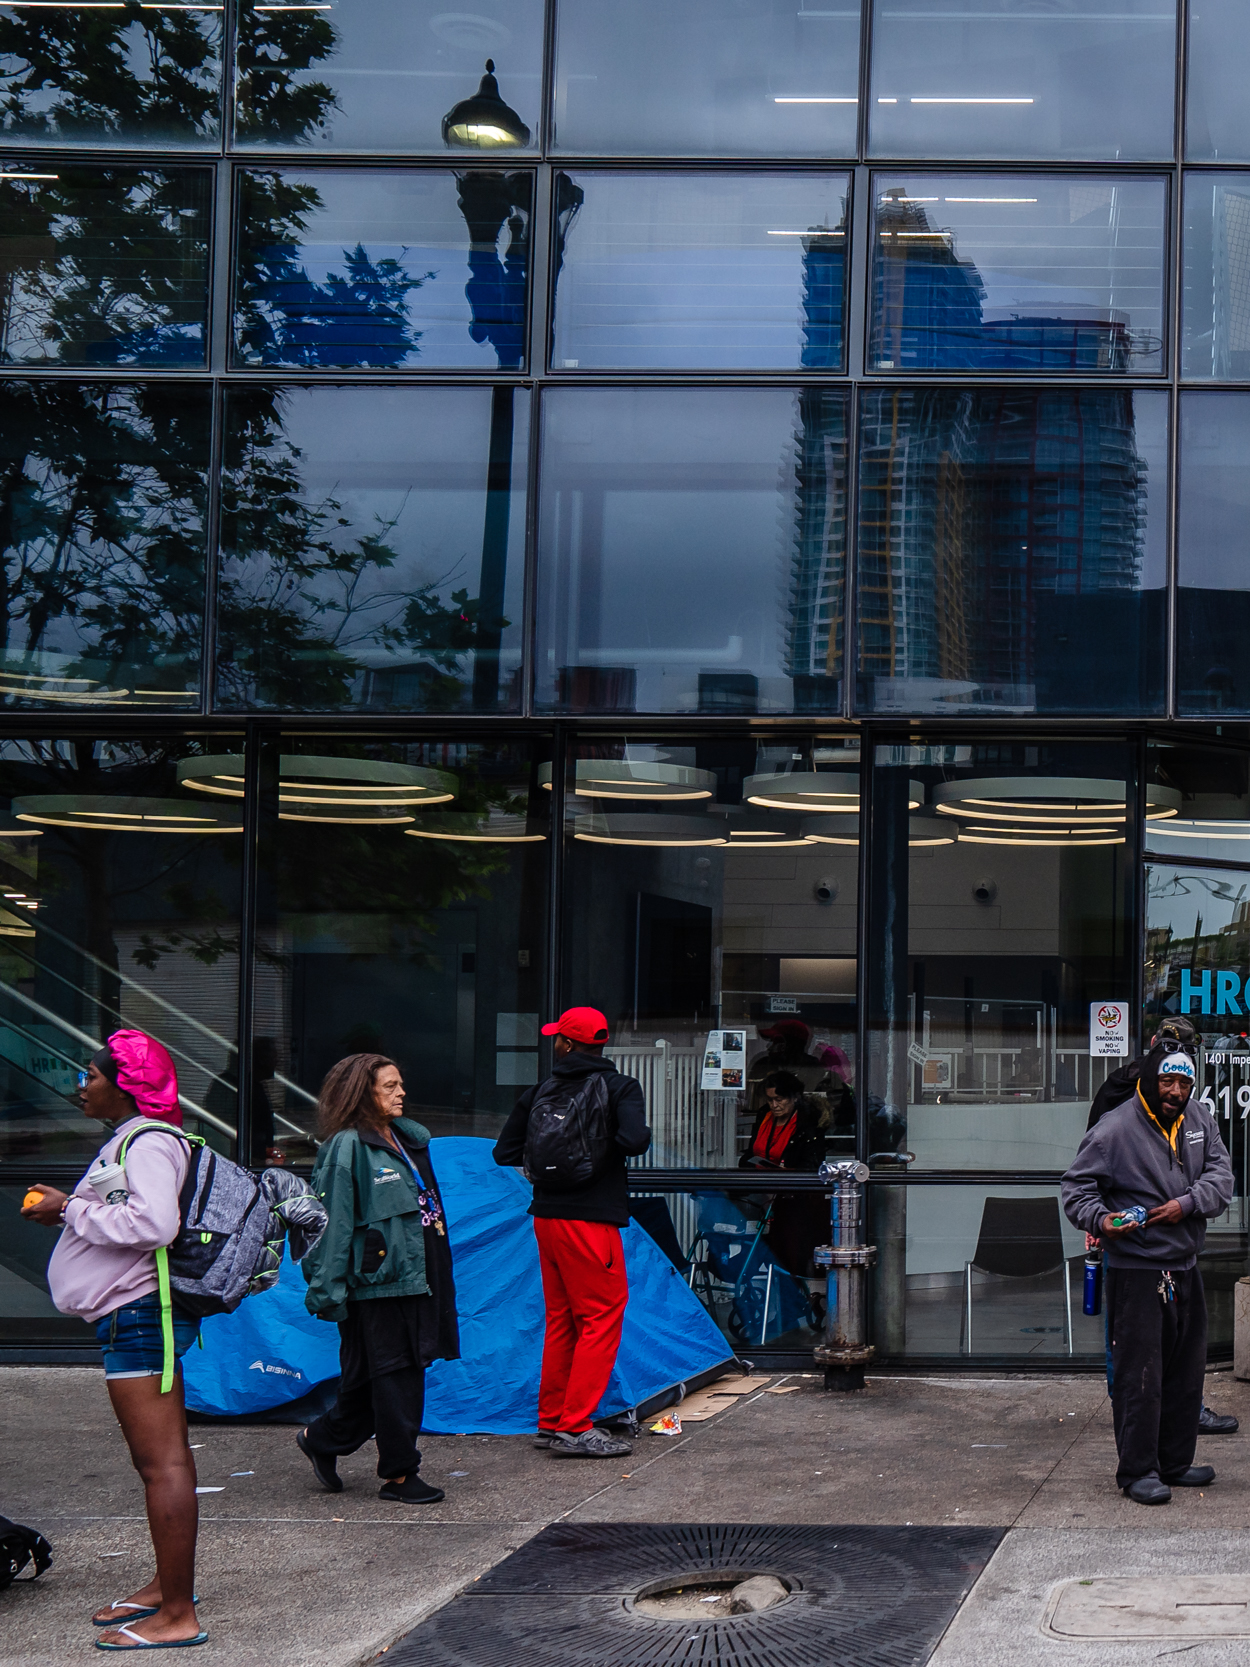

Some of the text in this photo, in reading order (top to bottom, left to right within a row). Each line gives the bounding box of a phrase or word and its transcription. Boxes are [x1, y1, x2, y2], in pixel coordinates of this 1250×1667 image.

[911, 1044, 928, 1059] PLEASE
[1205, 1053, 1226, 1064] 1401
[266, 1364, 302, 1380] BISINNA
